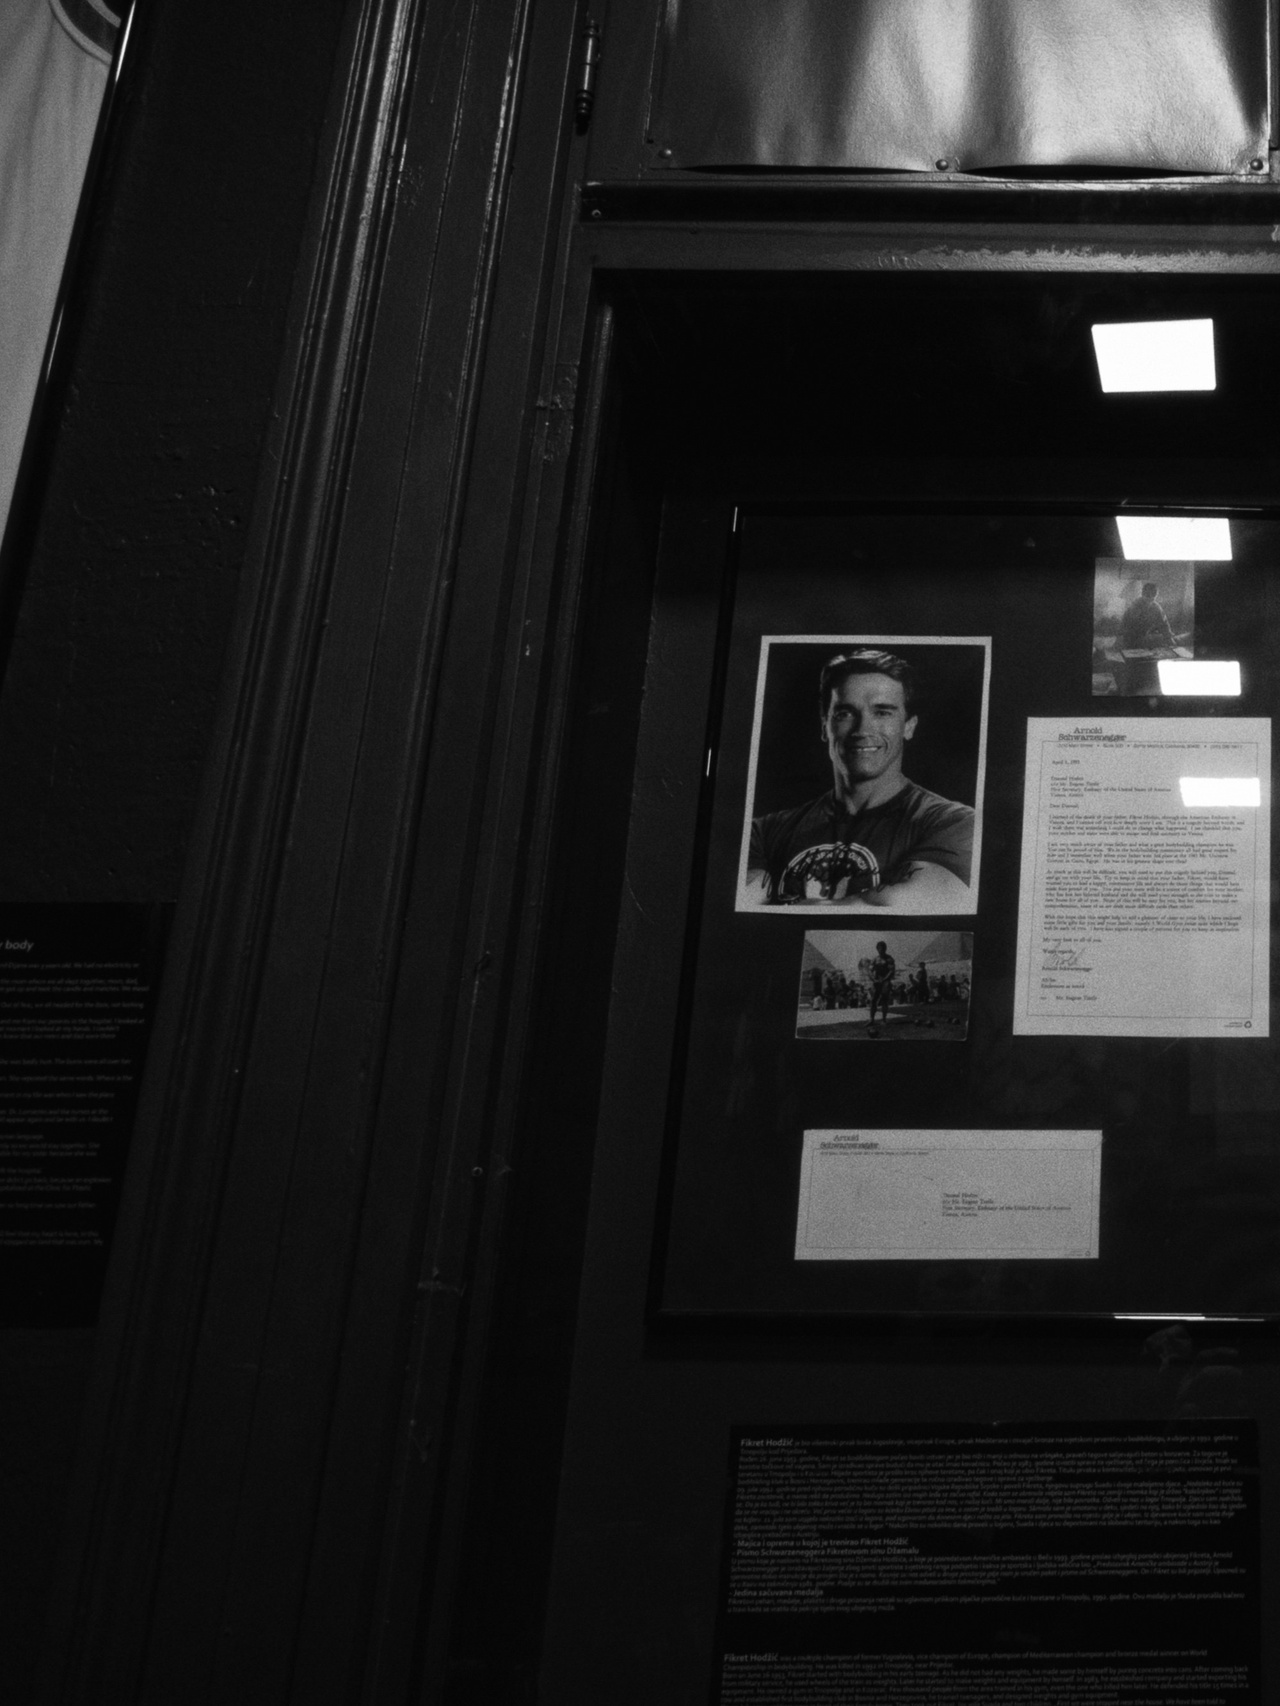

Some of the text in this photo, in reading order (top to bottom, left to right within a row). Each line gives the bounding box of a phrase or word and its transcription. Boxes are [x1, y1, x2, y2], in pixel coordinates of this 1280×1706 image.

[1073, 727, 1102, 735] Arnold
[1058, 733, 1126, 741] Schwarzenegger
[5, 938, 34, 953] body
[740, 1438, 764, 1447] Fikret
[766, 1437, 793, 1447] Hodžić
[737, 1539, 761, 1549] Majica
[766, 1541, 794, 1549] oprema
[802, 1539, 820, 1548] kojoj
[821, 1539, 828, 1548] je
[829, 1538, 859, 1546] trenirao
[860, 1537, 881, 1546] Fikret
[883, 1536, 909, 1546] Hodžić
[737, 1548, 759, 1556] Pismo
[760, 1548, 826, 1558] Schwarzeneggera
[827, 1547, 869, 1556] Fikretovom
[870, 1547, 886, 1555] sinu
[887, 1546, 920, 1555] Džamalu
[734, 1588, 758, 1597] Jedina
[759, 1588, 793, 1596] sačuvana
[794, 1587, 824, 1597] medalja
[724, 1652, 748, 1662] Fikret
[750, 1651, 779, 1662] Hodžić
